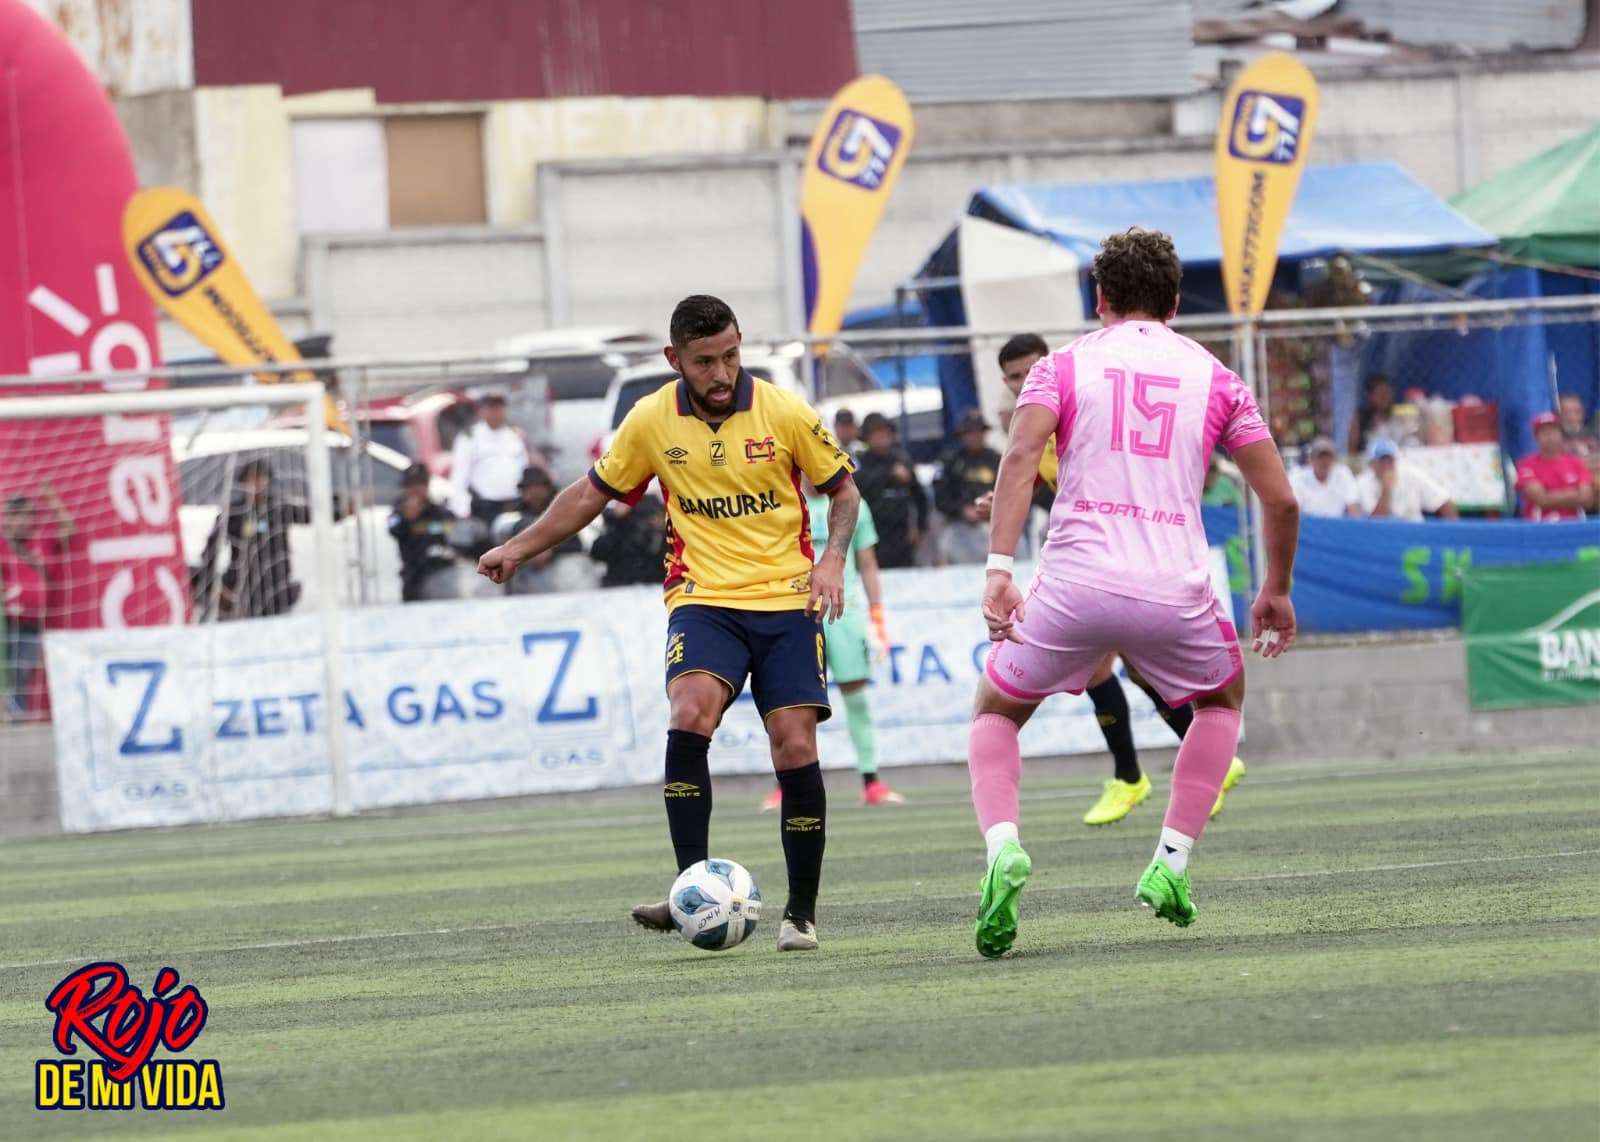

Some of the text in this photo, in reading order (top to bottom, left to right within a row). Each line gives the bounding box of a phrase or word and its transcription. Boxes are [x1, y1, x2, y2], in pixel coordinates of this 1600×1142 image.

[1103, 367, 1181, 460] 15
[676, 490, 782, 520] BANRURAL
[1072, 499, 1187, 527] SPORTLINE
[106, 660, 183, 757] Z
[386, 679, 504, 726] GAS
[521, 629, 599, 724] Z
